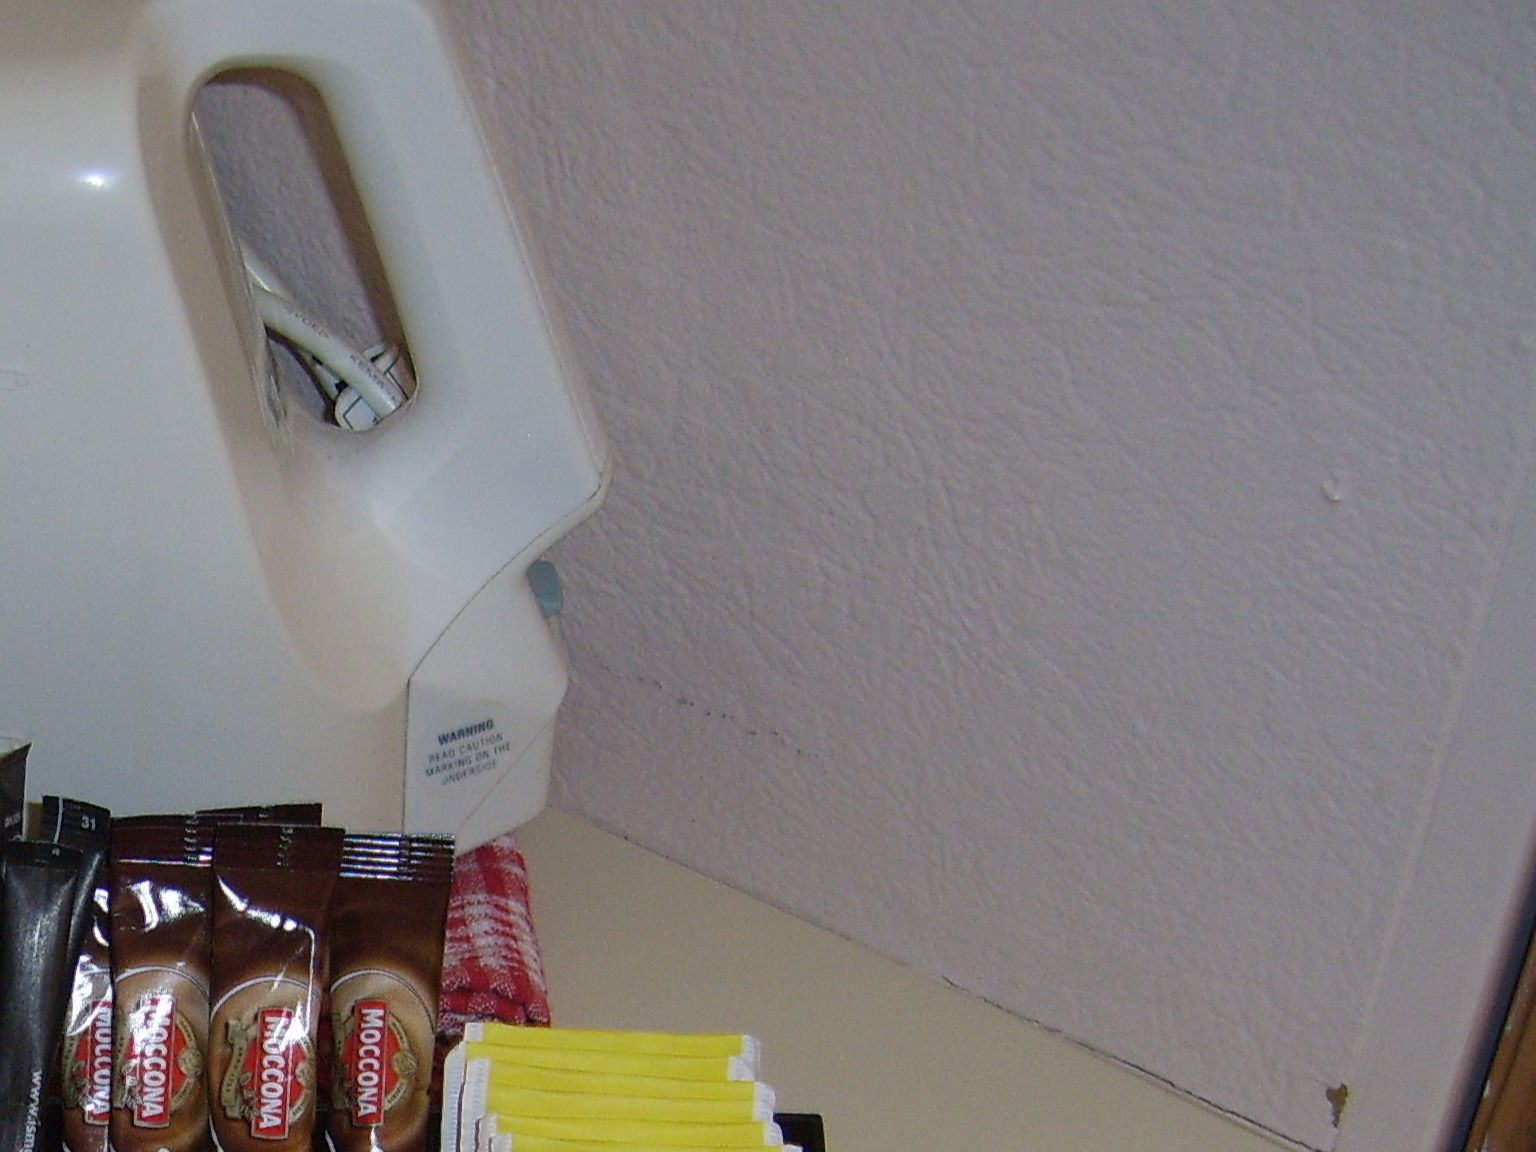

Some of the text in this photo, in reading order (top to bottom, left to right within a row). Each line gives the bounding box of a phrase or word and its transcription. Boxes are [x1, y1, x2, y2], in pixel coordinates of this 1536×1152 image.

[428, 732, 504, 764] READ CAUTION
[438, 717, 495, 746] WARNING
[259, 1015, 287, 1130] MOCCONA
[357, 1008, 385, 1117] MOCCONA
